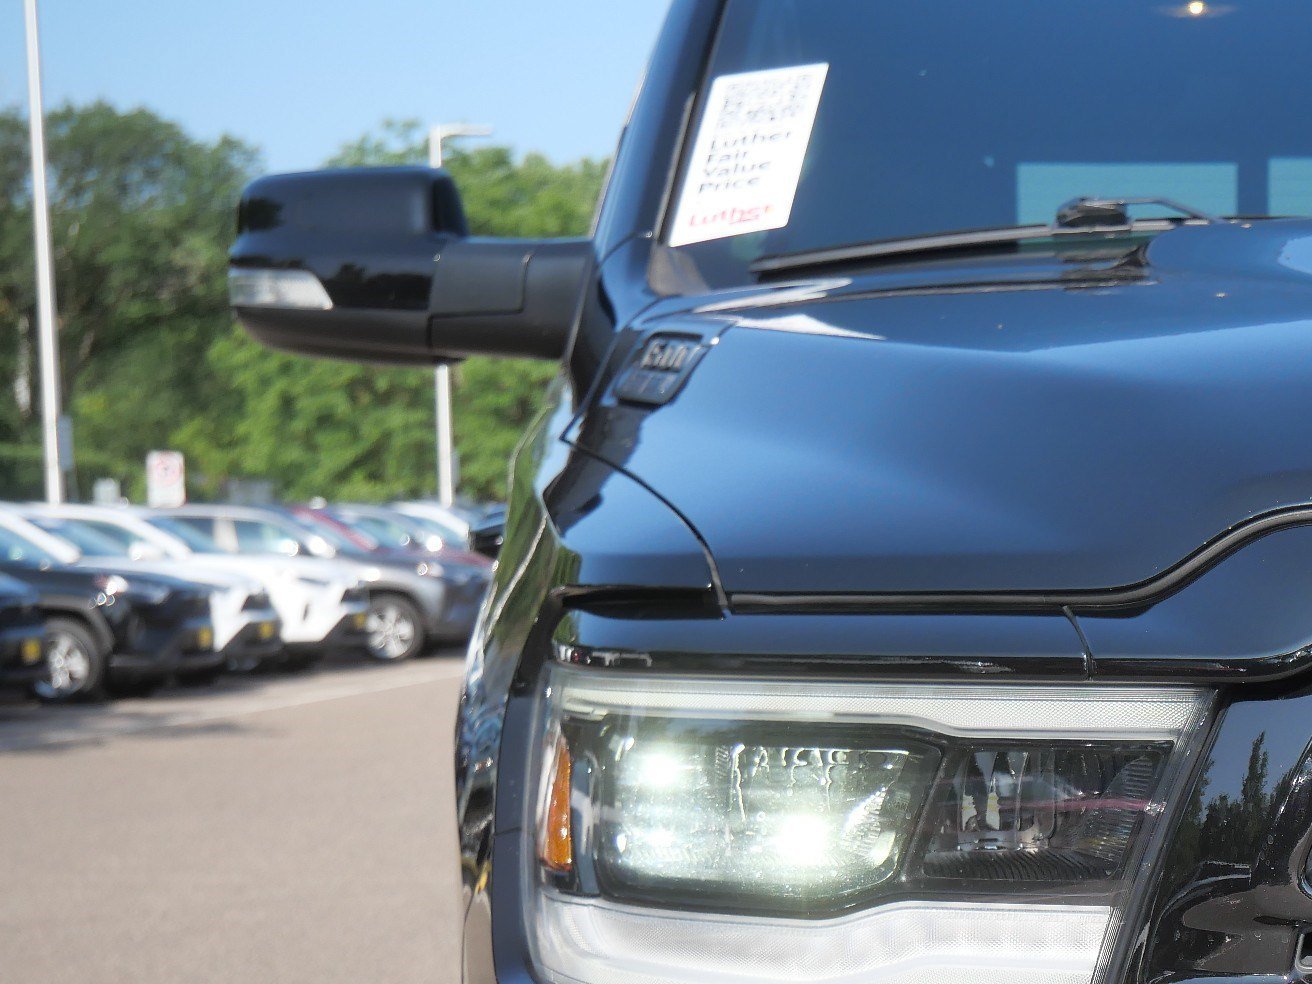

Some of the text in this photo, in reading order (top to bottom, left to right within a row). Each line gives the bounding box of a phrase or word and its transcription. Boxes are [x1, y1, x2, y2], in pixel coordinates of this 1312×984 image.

[711, 131, 792, 150] Luther
[706, 151, 749, 165] Fair
[703, 161, 771, 178] Value
[698, 177, 760, 194] Price
[688, 204, 775, 227] Luther
